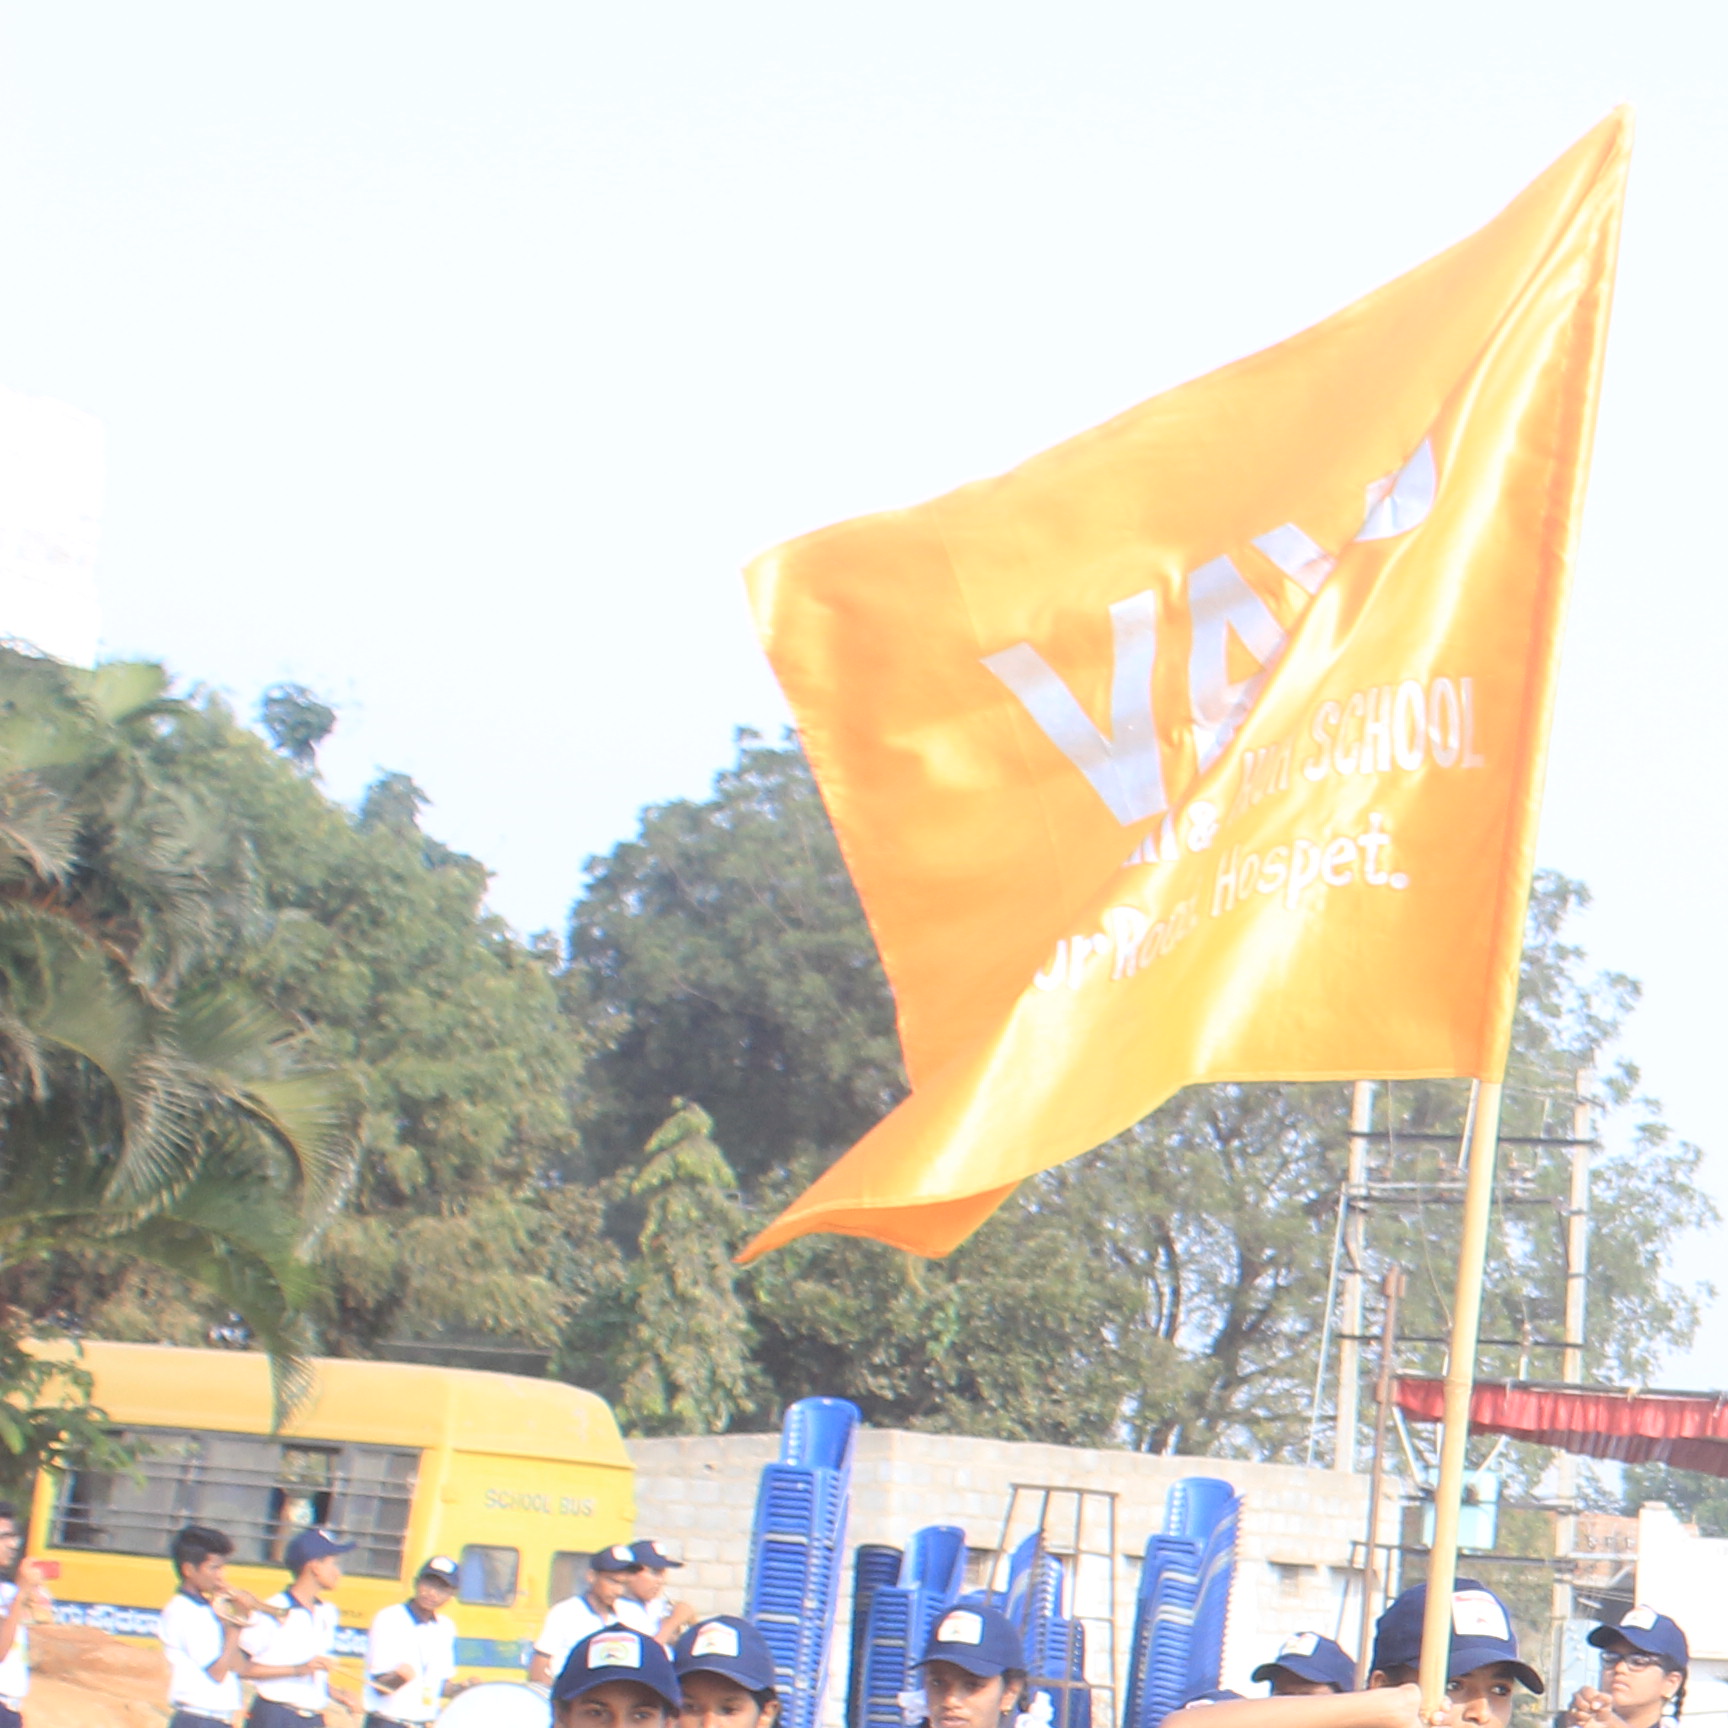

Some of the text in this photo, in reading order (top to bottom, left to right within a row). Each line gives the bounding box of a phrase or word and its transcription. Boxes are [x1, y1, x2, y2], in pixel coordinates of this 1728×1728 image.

[1302, 676, 1485, 782] SCHOOL
[1209, 811, 1410, 912] Hospet.
[483, 1488, 594, 1517] SCHOOL BUS
